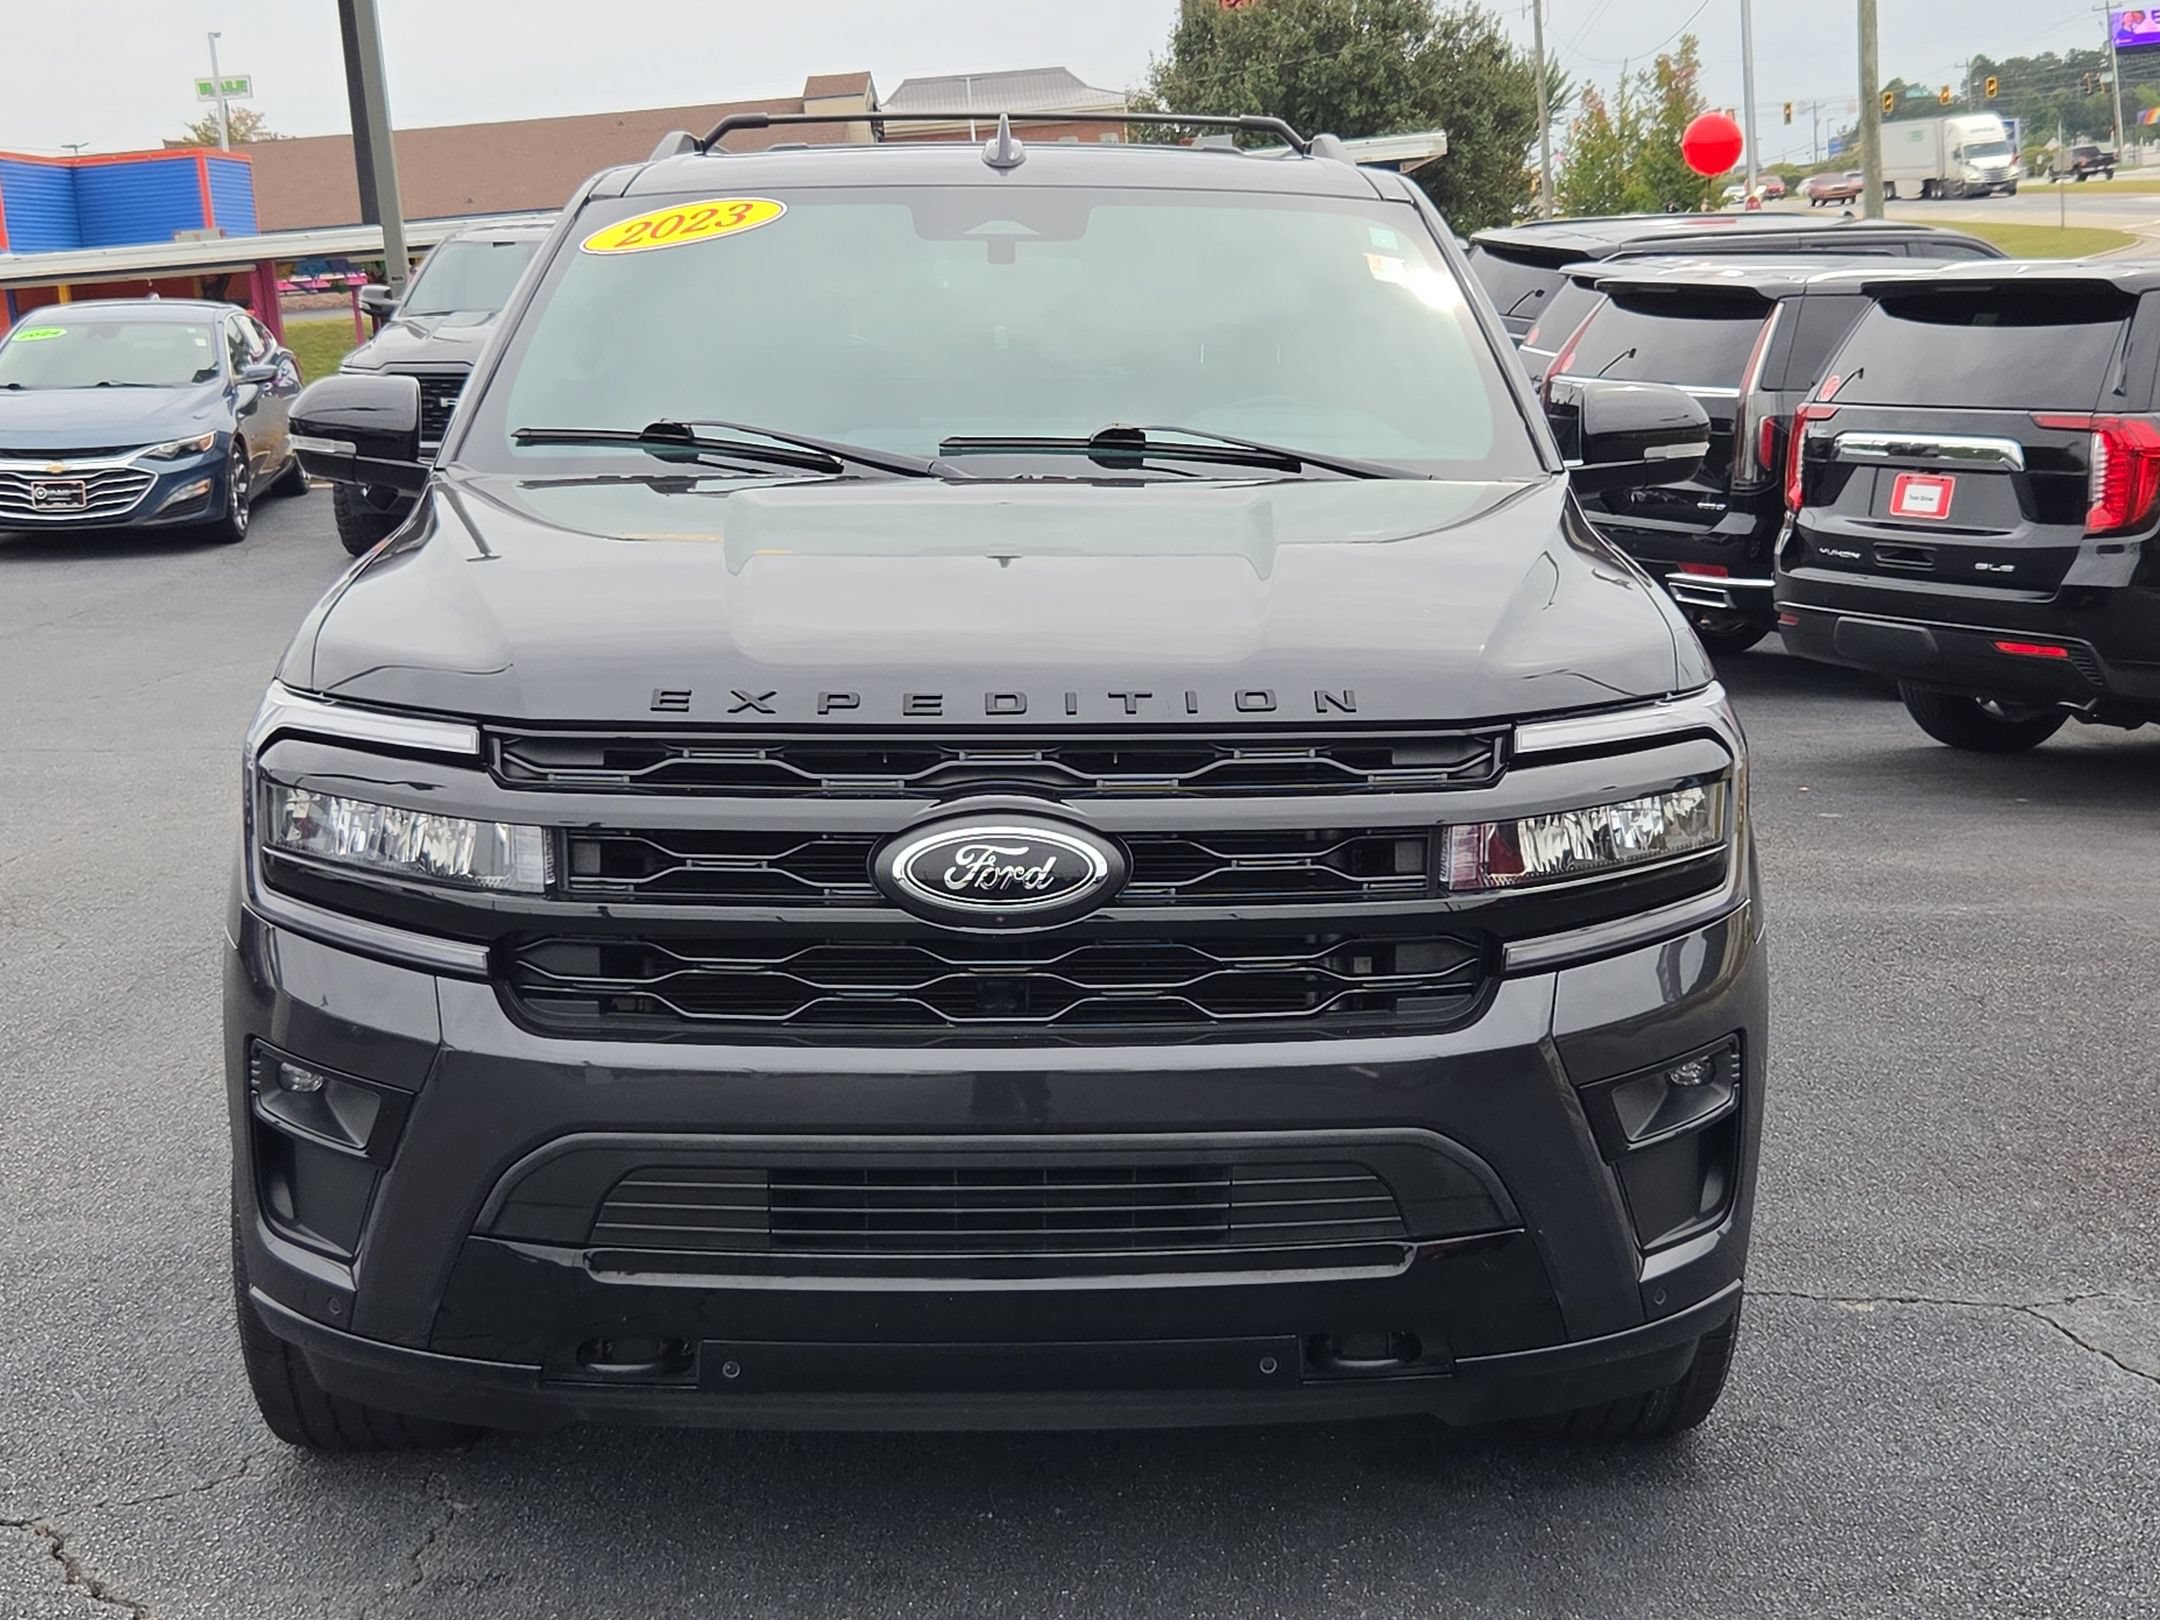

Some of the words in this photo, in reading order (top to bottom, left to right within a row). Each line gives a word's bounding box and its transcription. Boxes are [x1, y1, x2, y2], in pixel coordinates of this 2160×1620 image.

[614, 203, 754, 248] 2023
[650, 688, 1357, 715] EXPEDITION
[944, 844, 1057, 890] Ford
